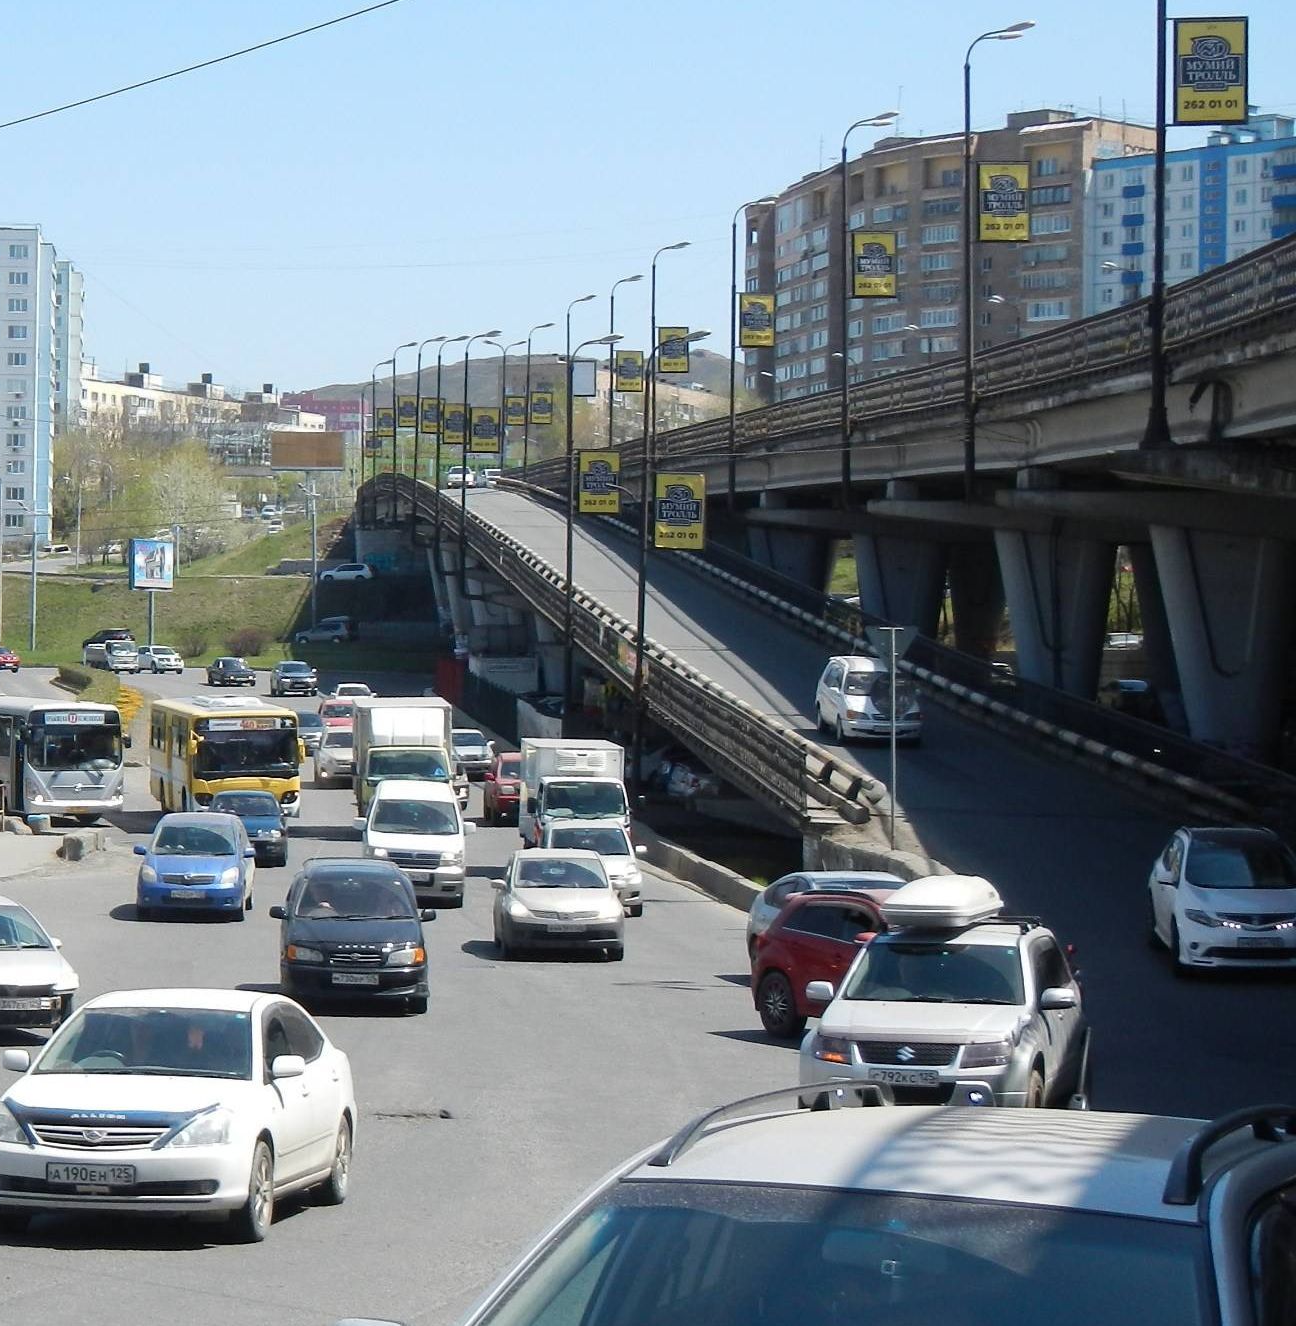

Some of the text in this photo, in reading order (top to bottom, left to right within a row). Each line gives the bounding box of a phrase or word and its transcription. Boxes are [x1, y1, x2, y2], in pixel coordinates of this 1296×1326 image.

[1186, 60, 1235, 71] МУМИЙ
[1186, 71, 1236, 81] ТРОЛЛЬ
[1184, 100, 1238, 109] 262 01 01
